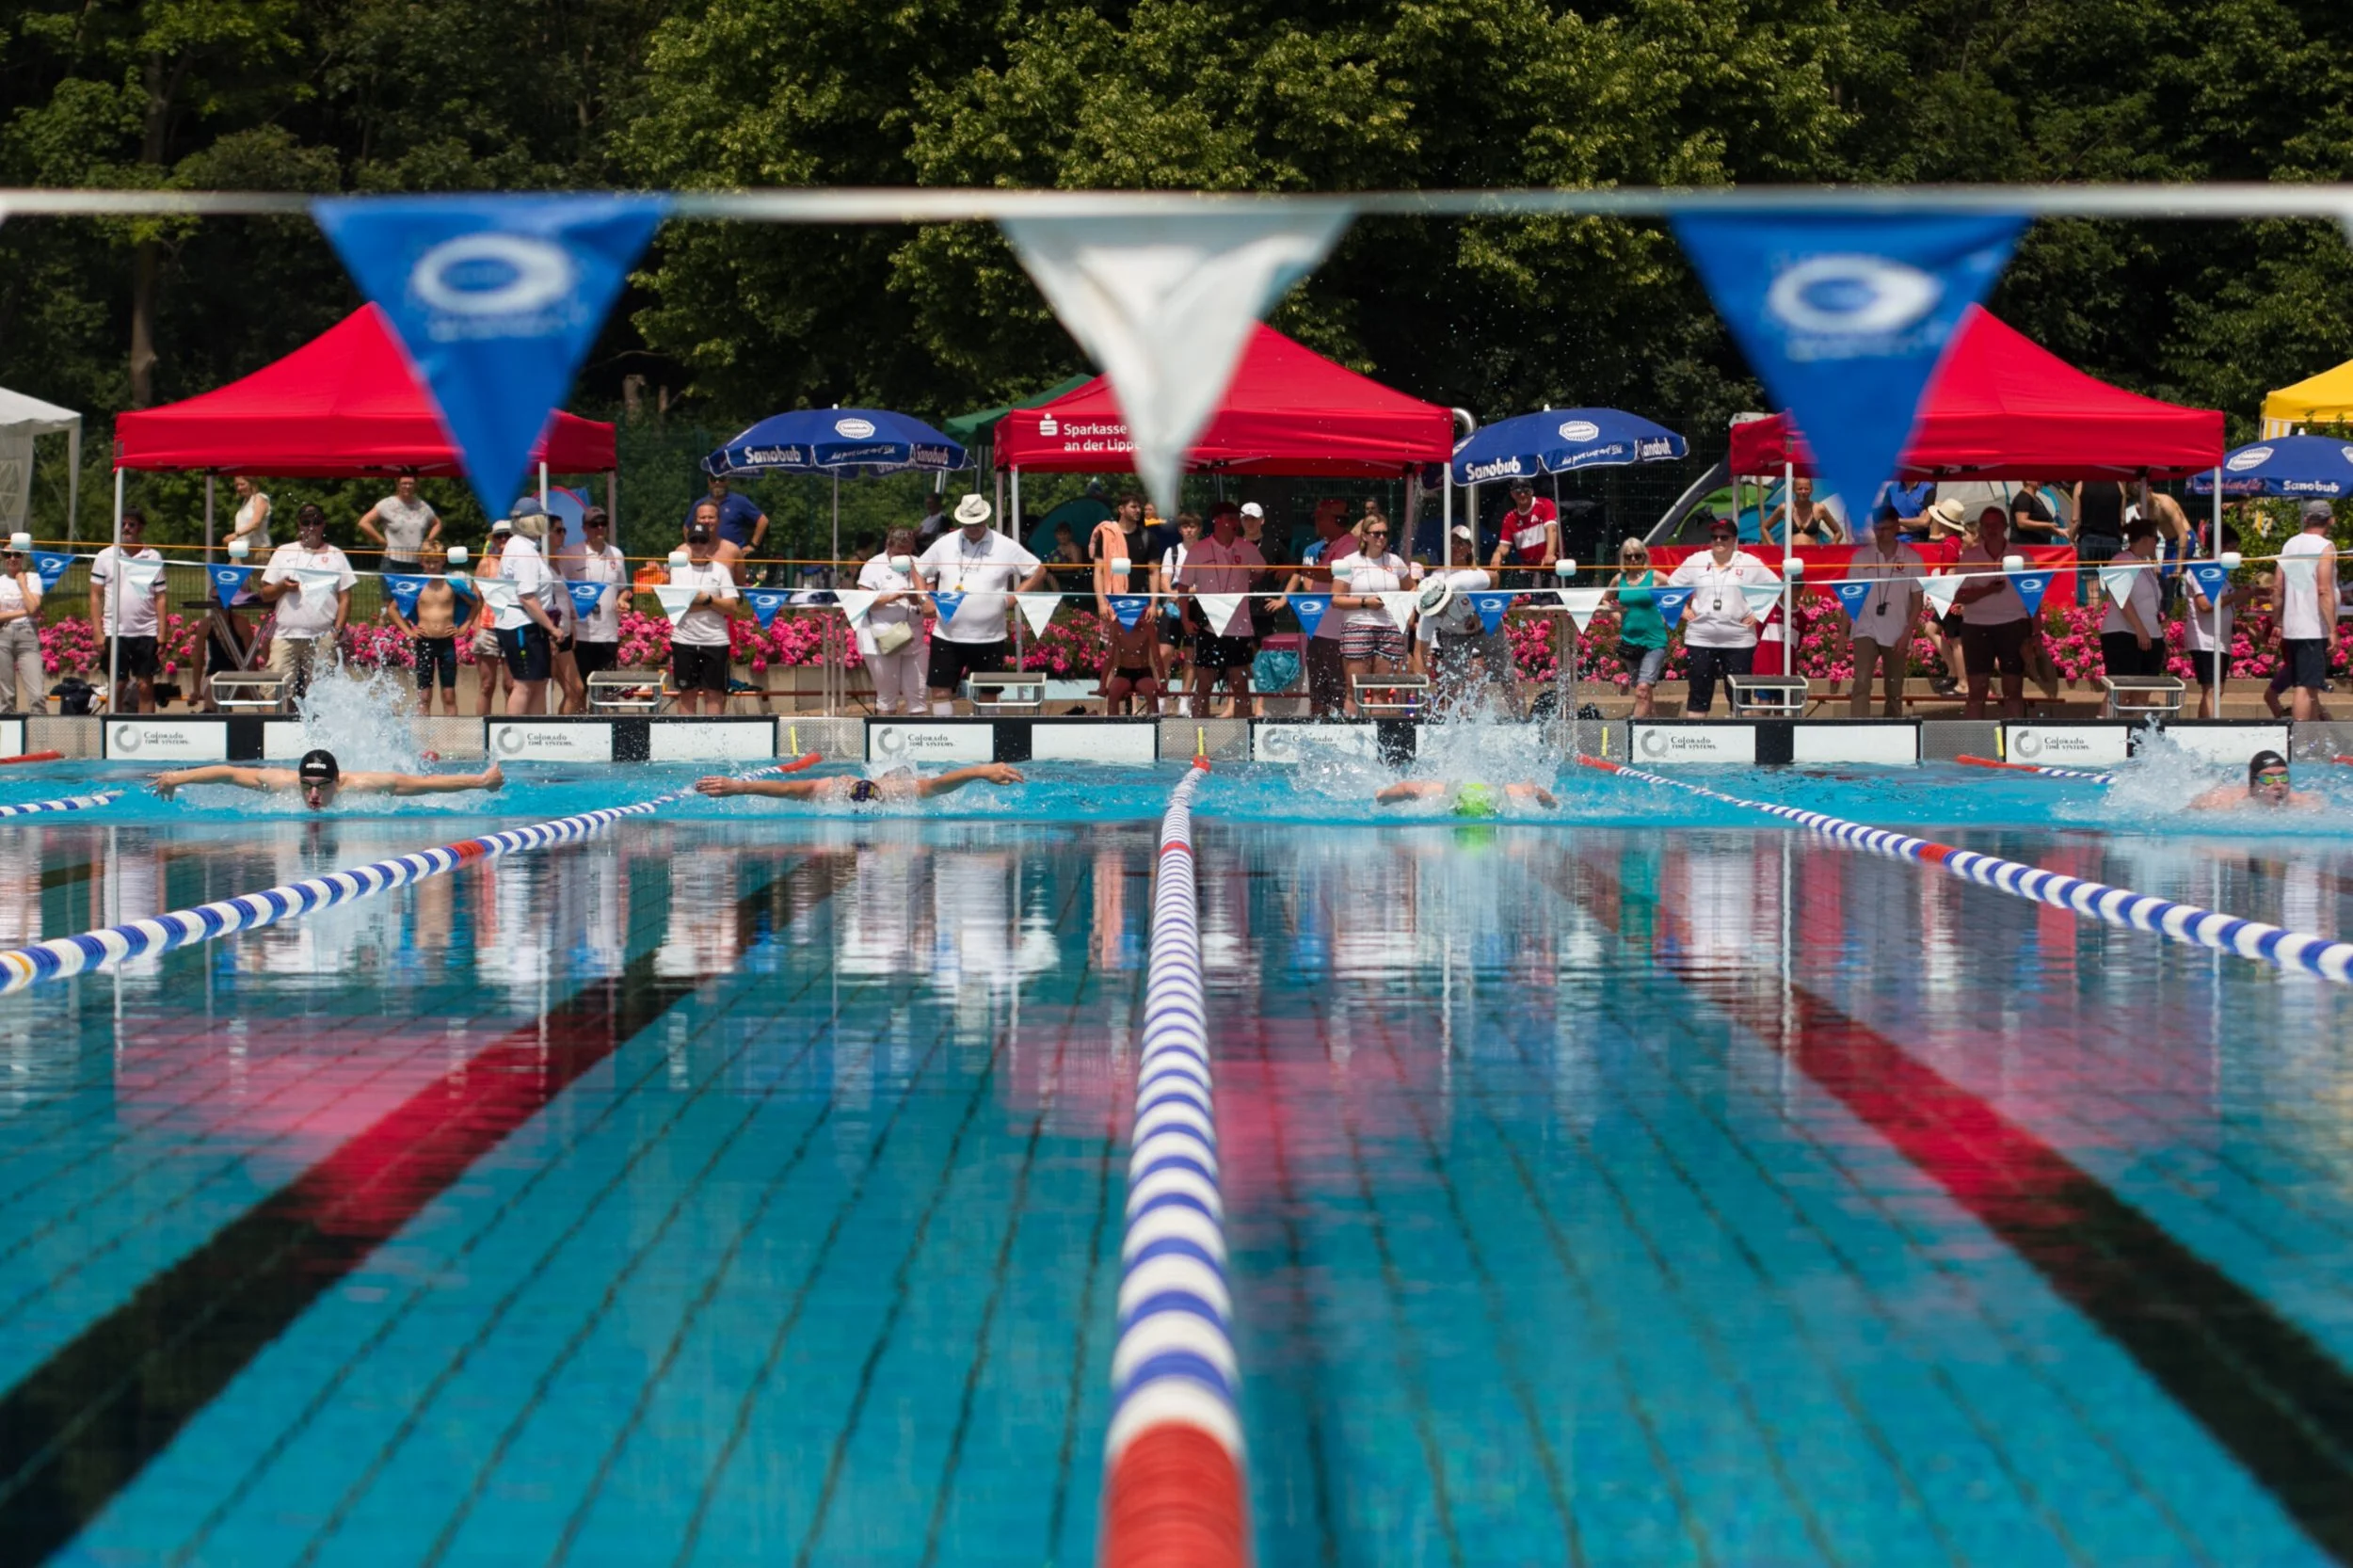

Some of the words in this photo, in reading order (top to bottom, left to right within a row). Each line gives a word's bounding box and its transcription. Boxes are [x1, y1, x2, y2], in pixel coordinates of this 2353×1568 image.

[1064, 423, 1128, 438] Sparkasse
[1064, 441, 1080, 452] an
[1083, 439, 1104, 452] der
[1107, 439, 1142, 453] Lippe
[744, 445, 802, 465] Sanobub
[916, 444, 950, 465] Sanobub
[1465, 456, 1521, 481] Sanobub
[2282, 480, 2341, 493] Sanobub
[144, 731, 184, 741] Colorado
[527, 733, 568, 742] Colorado
[908, 734, 949, 743] Colorado
[1671, 736, 1711, 744] Colorado
[2044, 737, 2085, 745] Colorado
